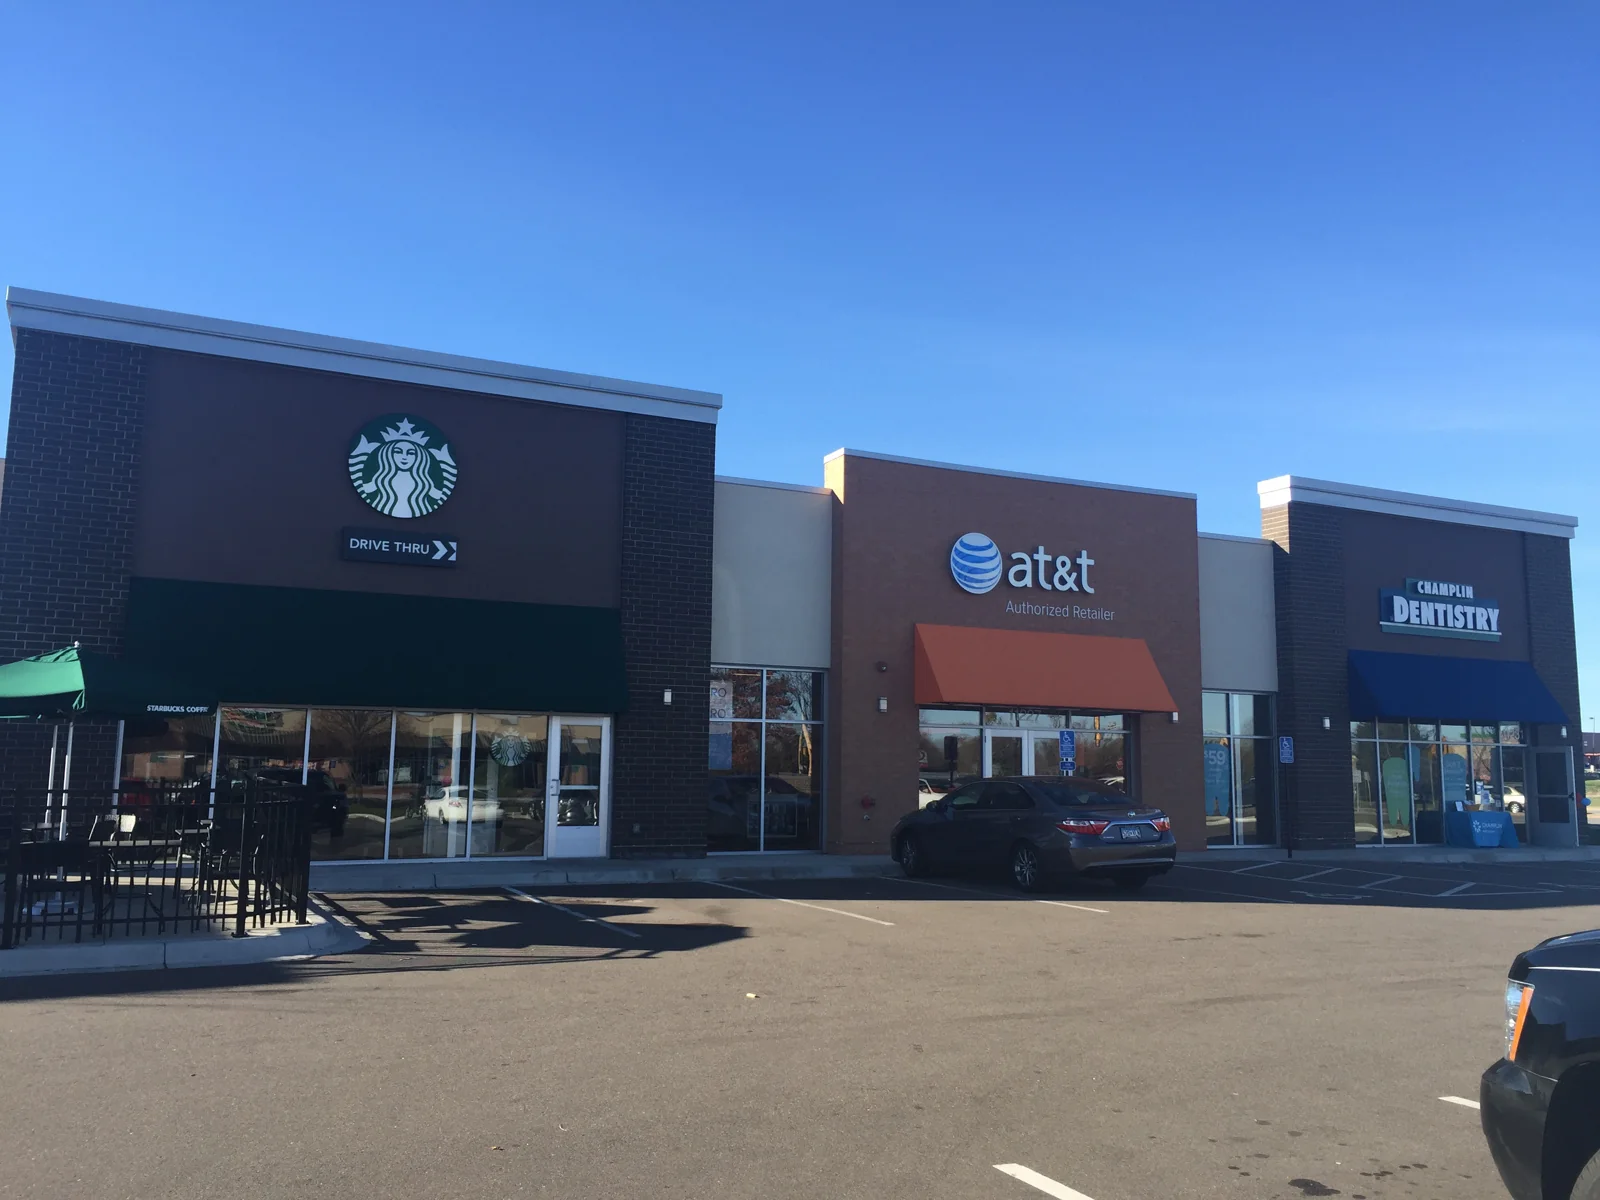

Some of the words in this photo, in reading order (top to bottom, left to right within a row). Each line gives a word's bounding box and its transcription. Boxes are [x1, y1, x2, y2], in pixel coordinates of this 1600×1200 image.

[349, 538, 390, 551] DRIVE
[394, 541, 430, 554] THRU
[1008, 545, 1095, 594] at&t
[1417, 580, 1474, 599] CHAMPLIN
[1005, 600, 1069, 617] Authorized
[1073, 605, 1115, 621] Retailer
[1393, 595, 1500, 631] DENTISTRY
[146, 704, 185, 713] STARBUCKS
